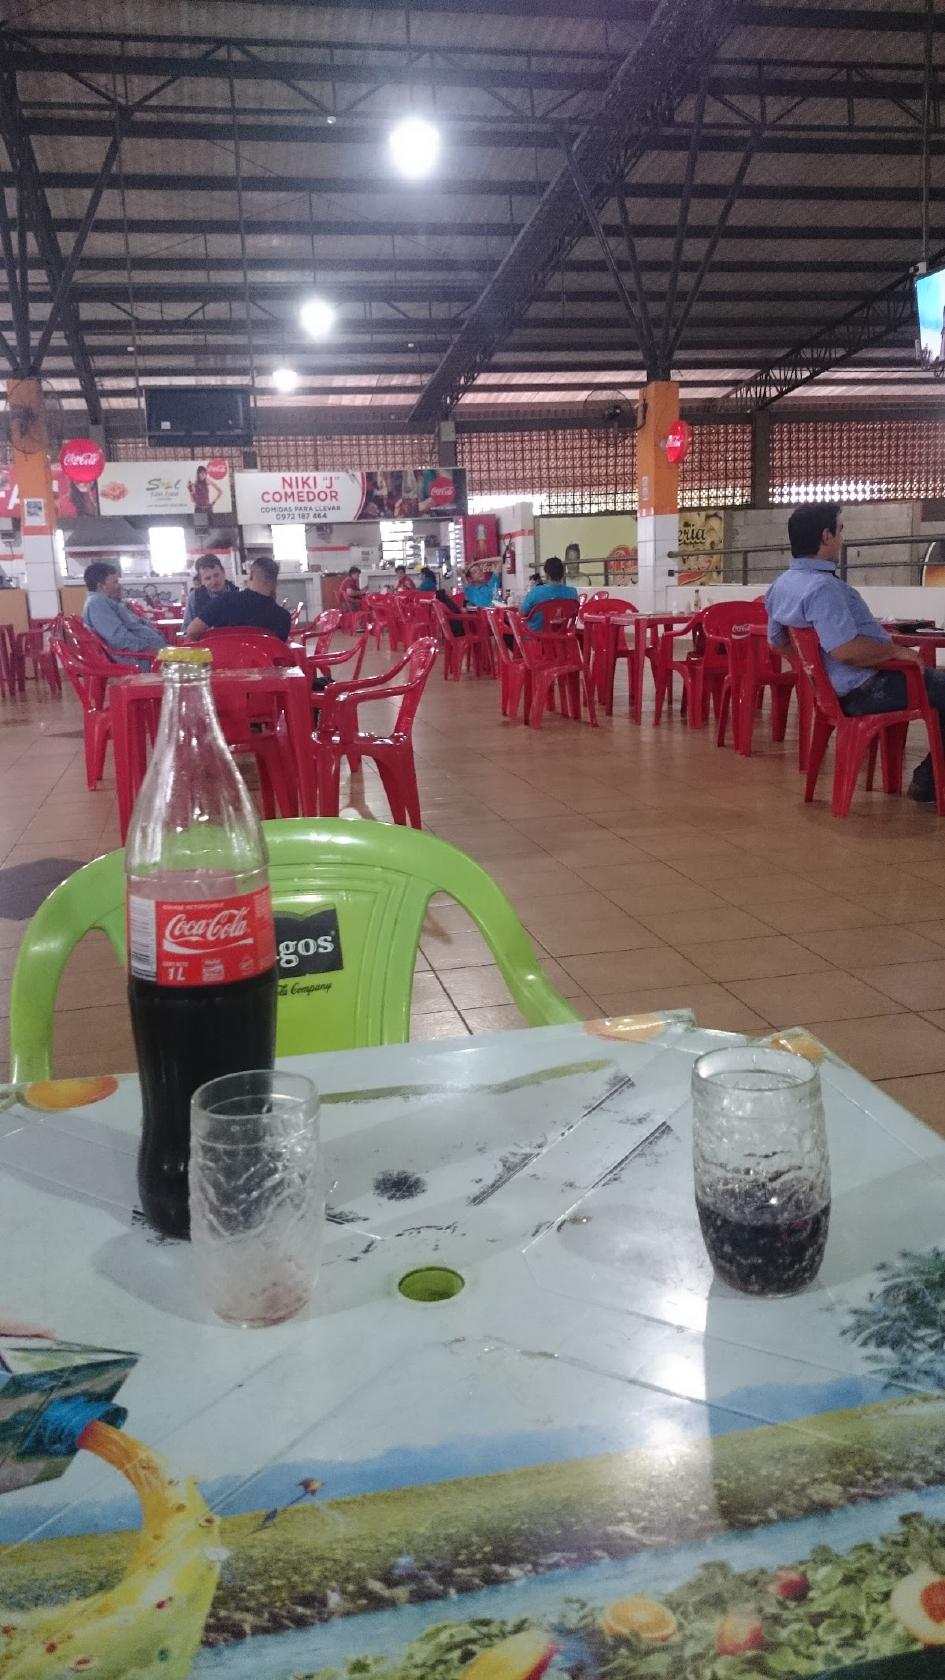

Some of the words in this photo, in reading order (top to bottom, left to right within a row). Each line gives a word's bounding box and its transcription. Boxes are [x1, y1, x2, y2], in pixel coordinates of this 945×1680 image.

[281, 476, 317, 489] NIKI
[261, 490, 339, 503] COMEDOR
[165, 907, 249, 942] Coca-Cola
[291, 982, 332, 996] Company
